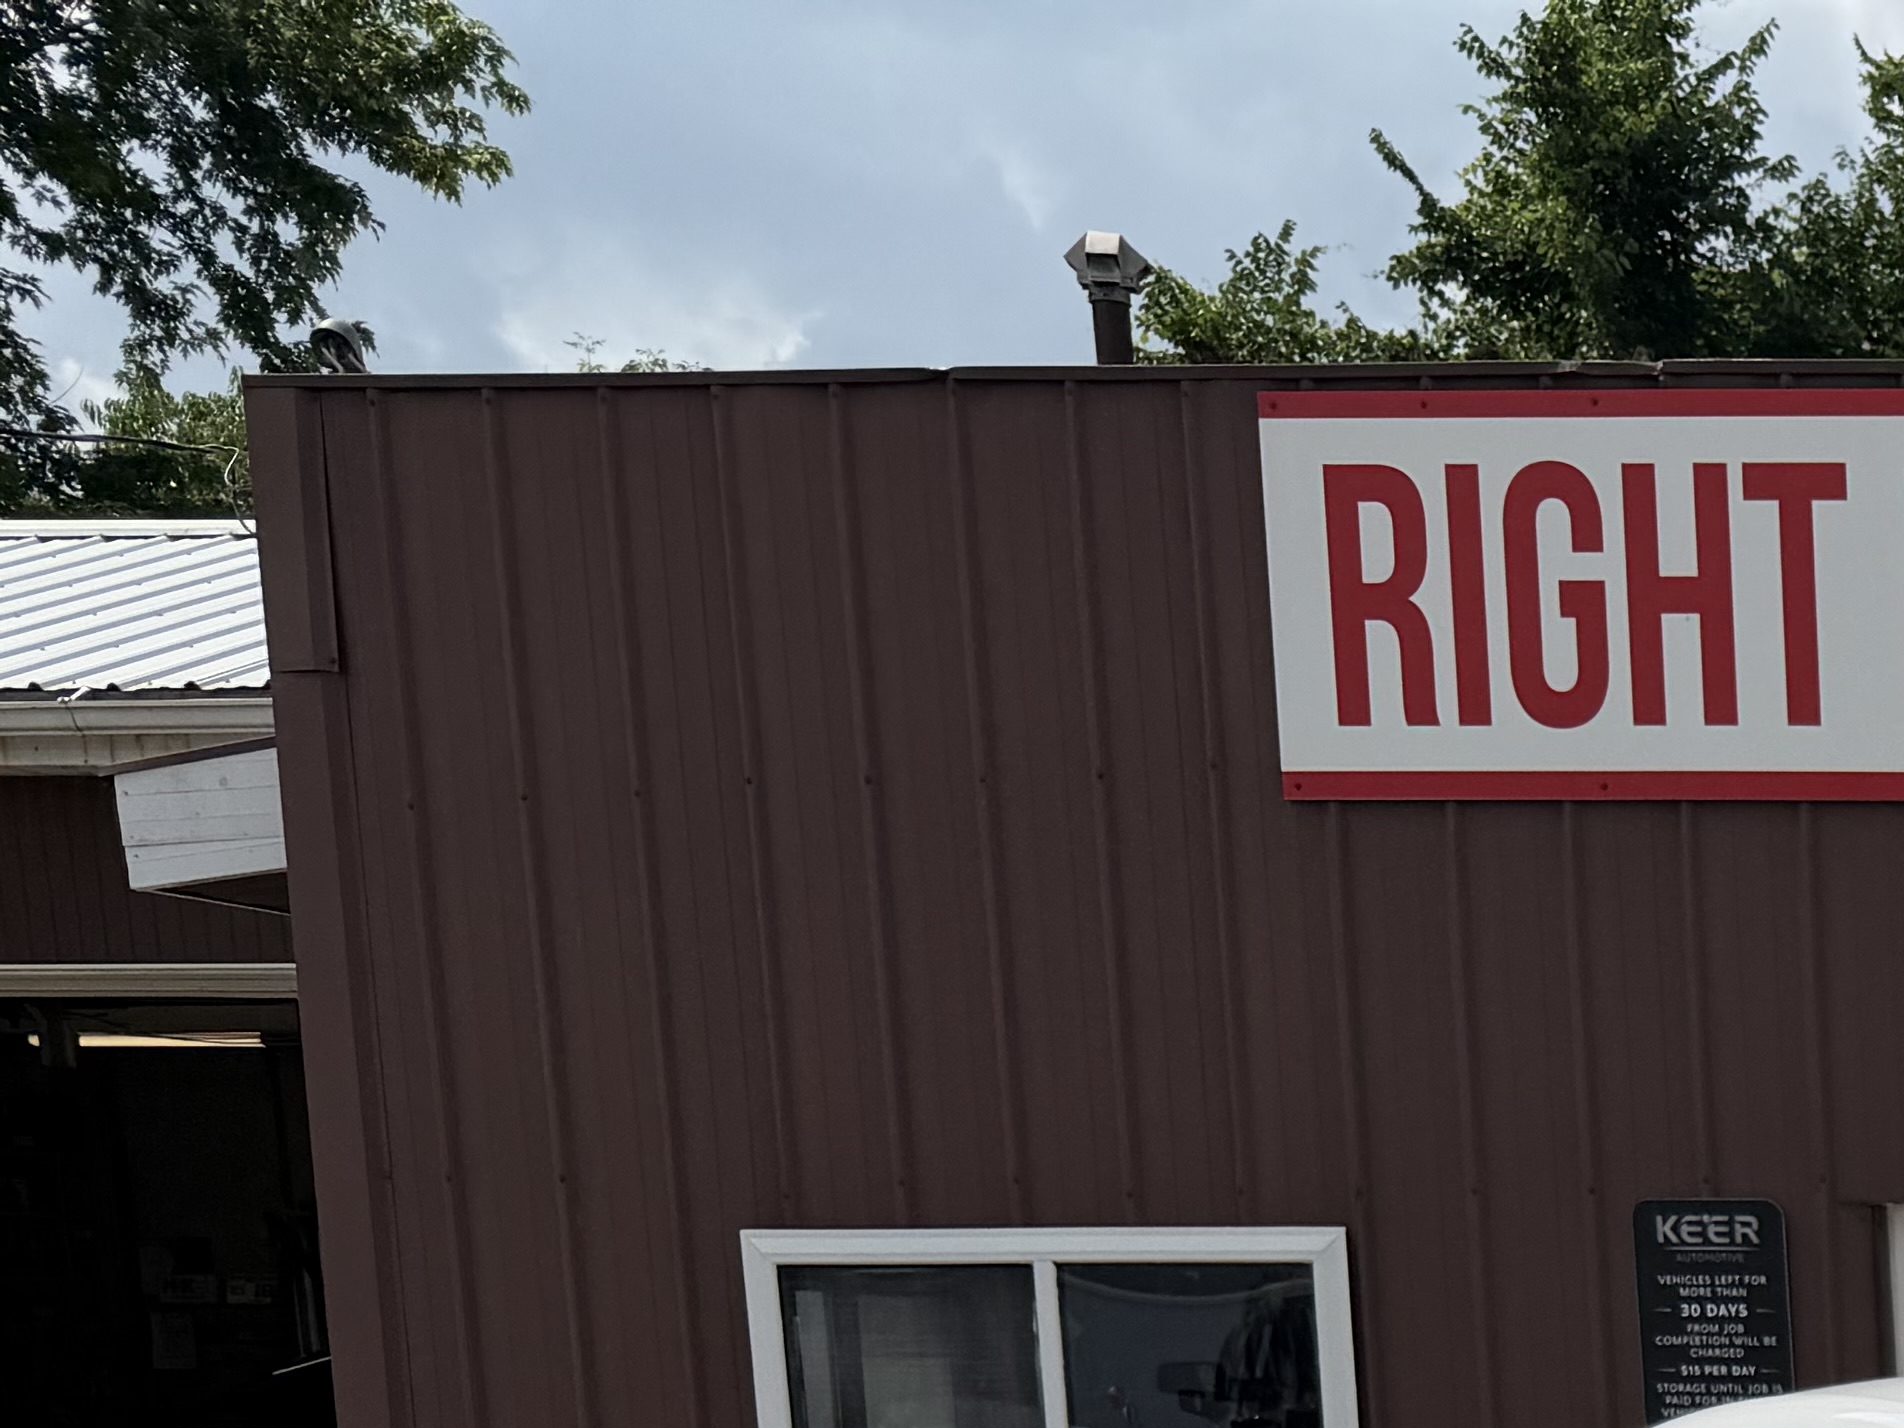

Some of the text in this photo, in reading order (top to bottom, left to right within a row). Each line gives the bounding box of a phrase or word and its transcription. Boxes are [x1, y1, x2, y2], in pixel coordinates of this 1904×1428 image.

[1323, 462, 1847, 728] RIGHT
[1656, 1214, 1759, 1243] KEER
[1657, 1274, 1767, 1286] VEHICLES LEFT FOR
[1679, 1286, 1747, 1298] MORE THAN
[1680, 1303, 1748, 1318] 30 DAYS
[1686, 1323, 1745, 1335] FROM JOB
[1655, 1335, 1777, 1347] COMPLETION WILL BE
[1689, 1347, 1745, 1359] CHARGED
[1680, 1364, 1756, 1377] $15 PER DAY
[1656, 1382, 1707, 1394] STORAGE
[1710, 1383, 1744, 1395] UNTIL
[1747, 1383, 1769, 1395] JOB
